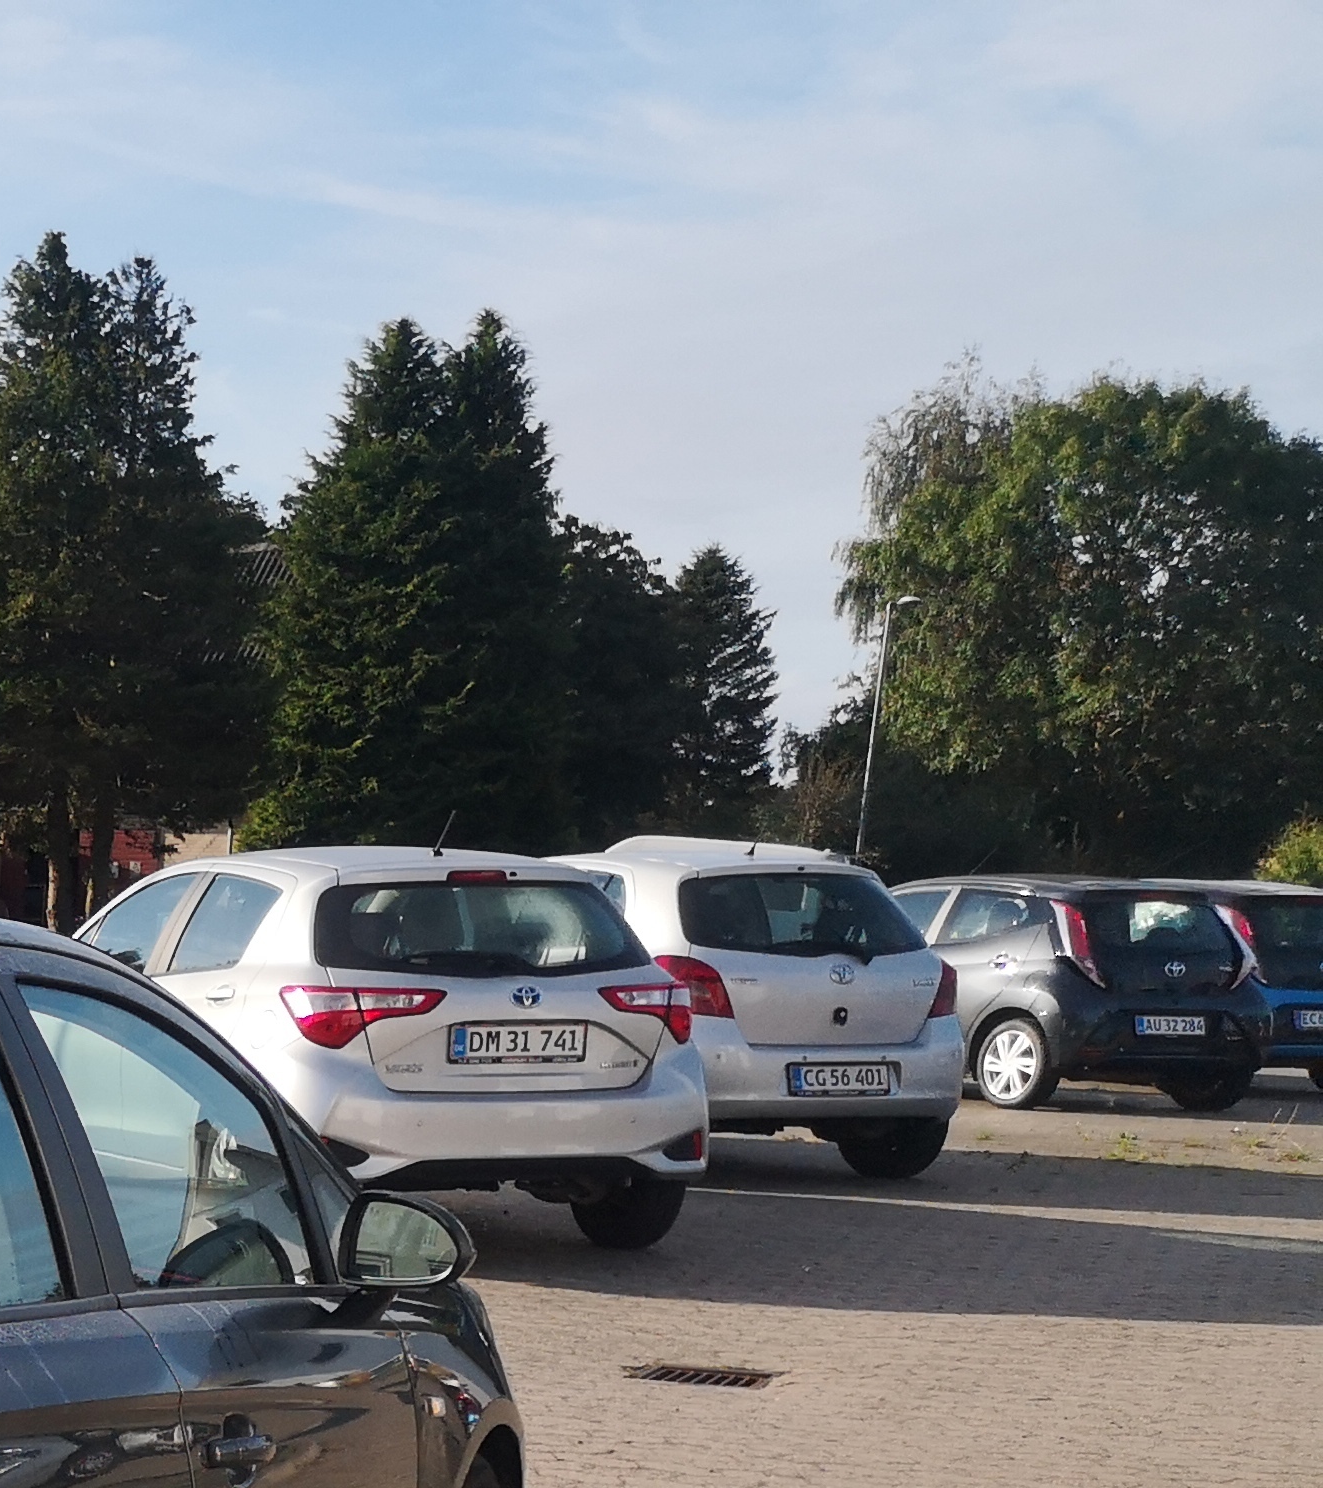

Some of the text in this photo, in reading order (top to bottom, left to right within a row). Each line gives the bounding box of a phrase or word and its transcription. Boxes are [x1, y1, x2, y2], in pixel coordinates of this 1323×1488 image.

[1146, 1018, 1161, 1032] AU
[1162, 1018, 1179, 1032] 32
[469, 1029, 578, 1053] DM 31 741
[803, 1068, 884, 1087] CG 56 401
